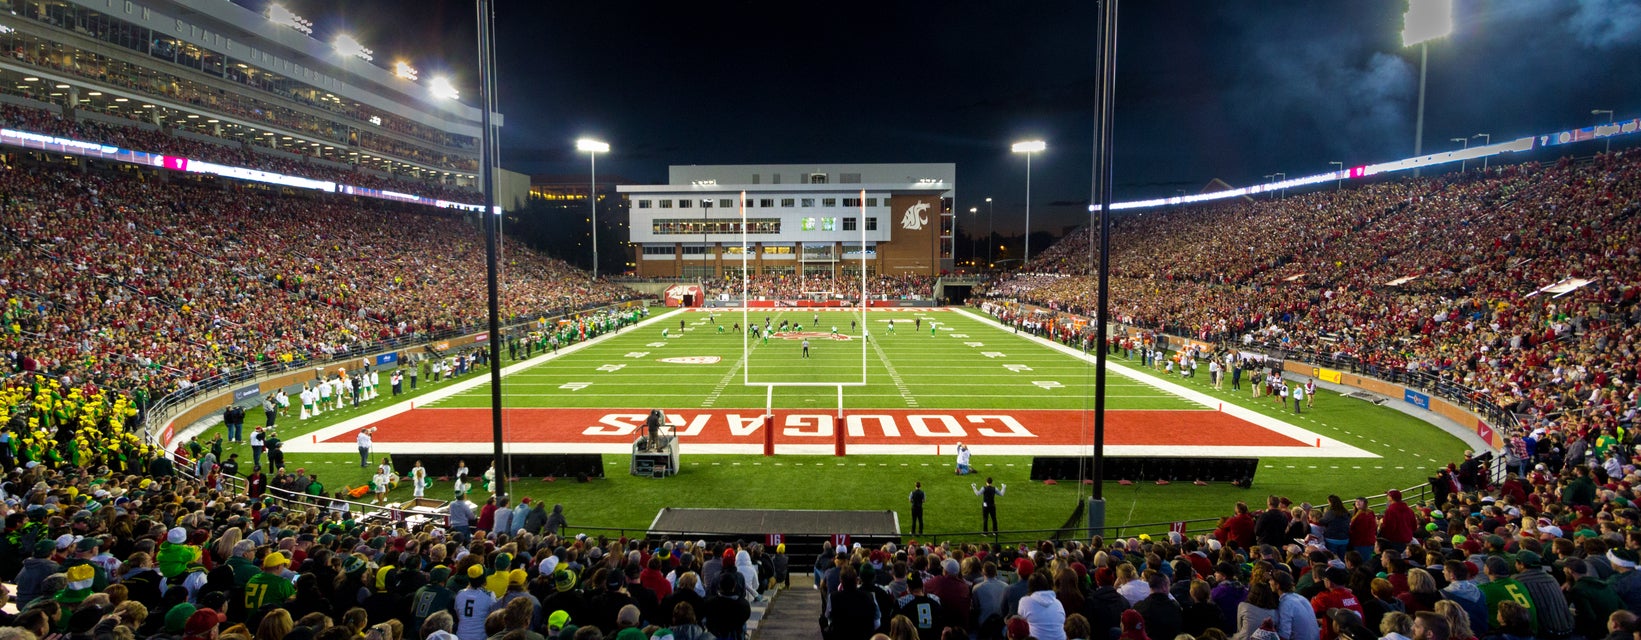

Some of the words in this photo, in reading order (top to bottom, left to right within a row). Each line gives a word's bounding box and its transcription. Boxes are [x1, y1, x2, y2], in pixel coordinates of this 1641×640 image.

[175, 19, 232, 50] STATE
[250, 47, 345, 93] UNIVERSITY
[582, 413, 1039, 438] COUGARS
[770, 533, 781, 546] 16
[835, 533, 846, 546] 17
[244, 583, 269, 609] 21
[415, 591, 437, 618] 8
[464, 599, 475, 617] 6
[1504, 584, 1531, 609] 6
[917, 602, 933, 629] 8
